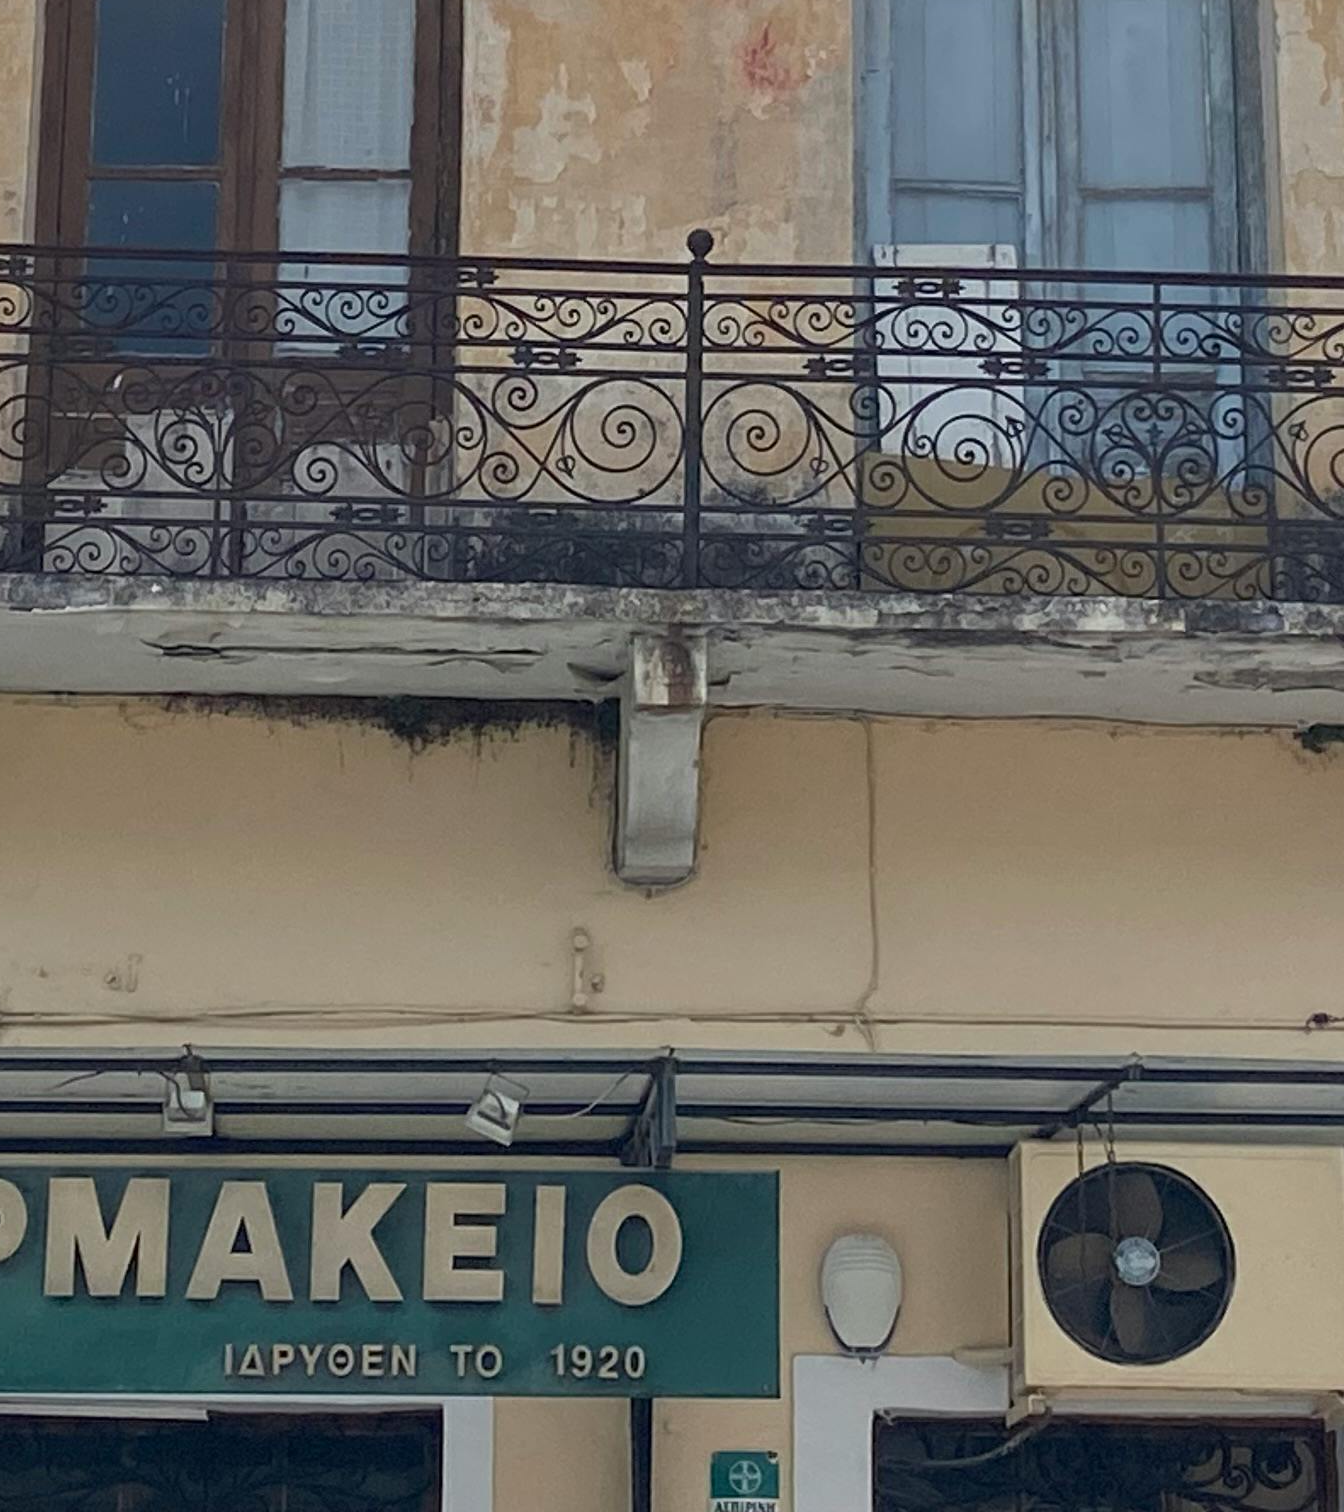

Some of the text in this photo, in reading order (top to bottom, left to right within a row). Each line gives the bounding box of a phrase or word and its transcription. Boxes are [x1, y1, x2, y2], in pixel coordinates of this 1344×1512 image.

[223, 1342, 647, 1380] ΙΔΡΥΘΕΝ ΤΟ 1920
